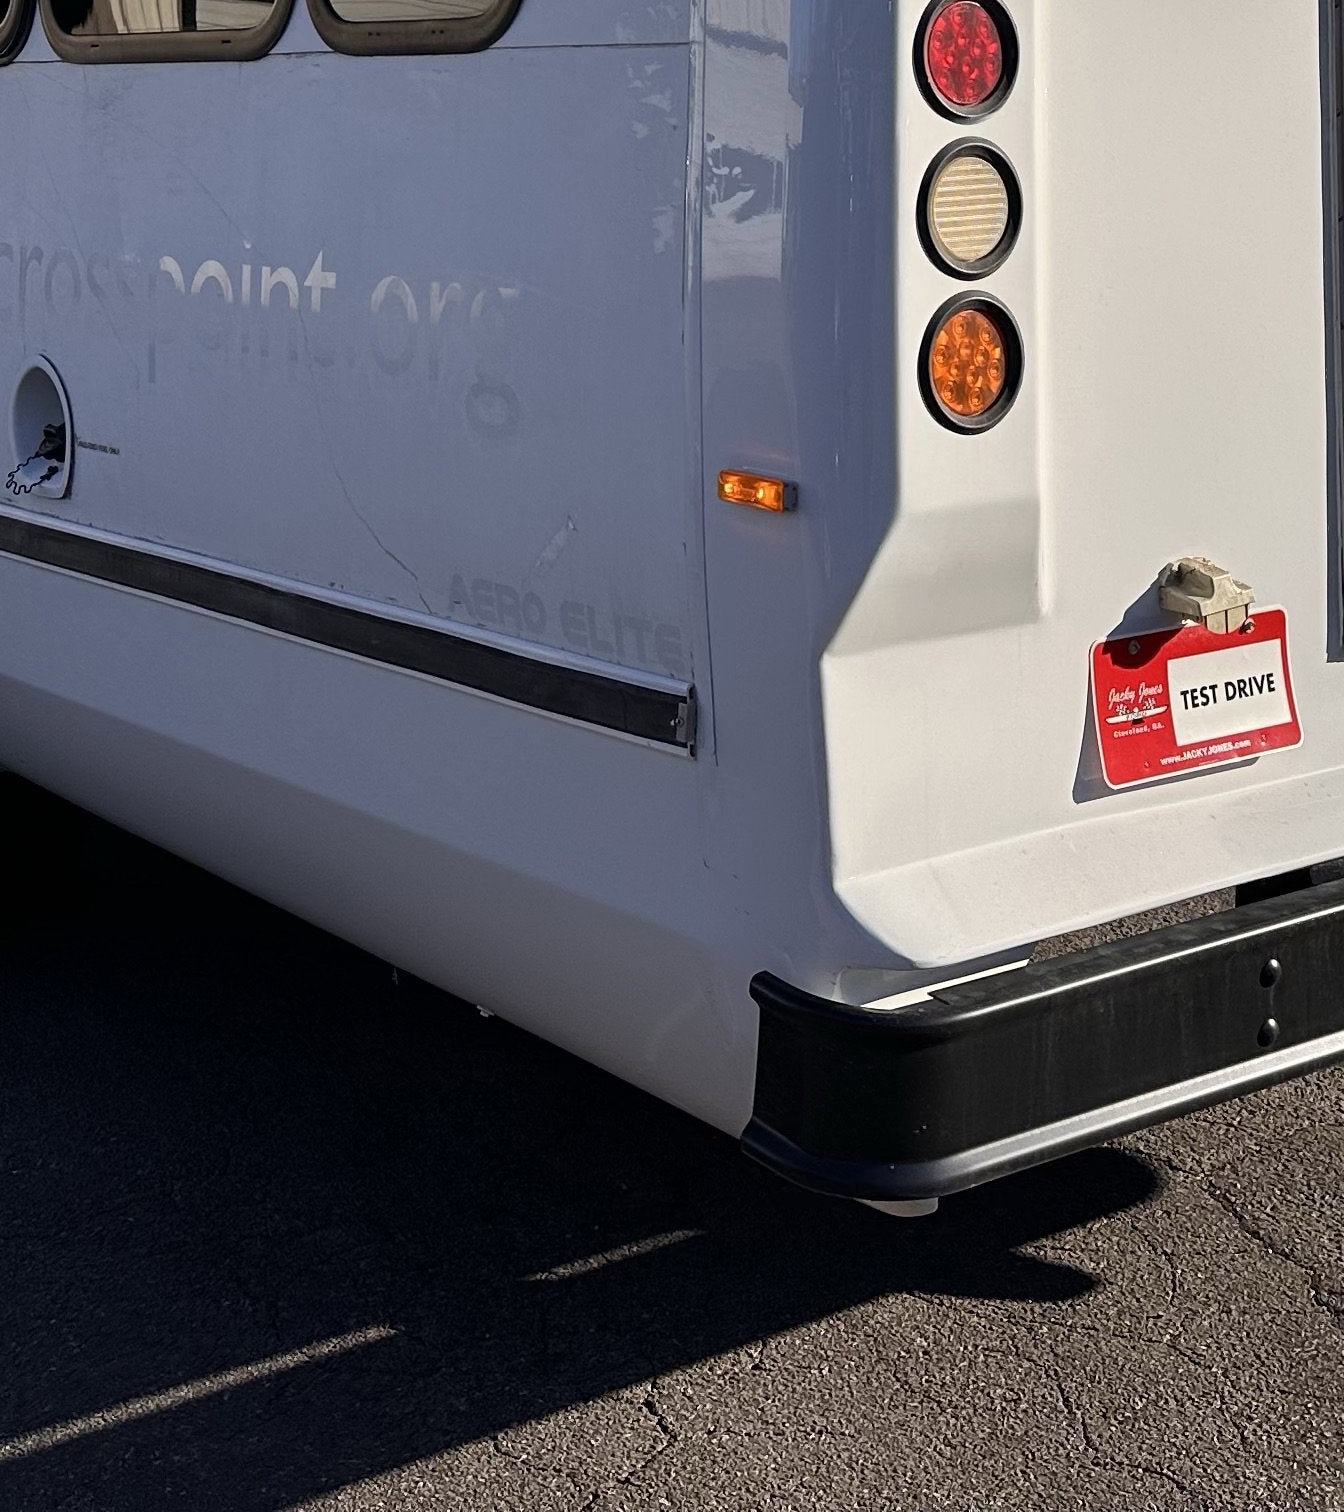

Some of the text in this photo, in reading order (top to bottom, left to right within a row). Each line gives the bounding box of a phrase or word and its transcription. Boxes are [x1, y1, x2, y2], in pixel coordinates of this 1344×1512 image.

[449, 573, 687, 675] AERO ELITE
[1180, 673, 1276, 710] TEST DRIVE
